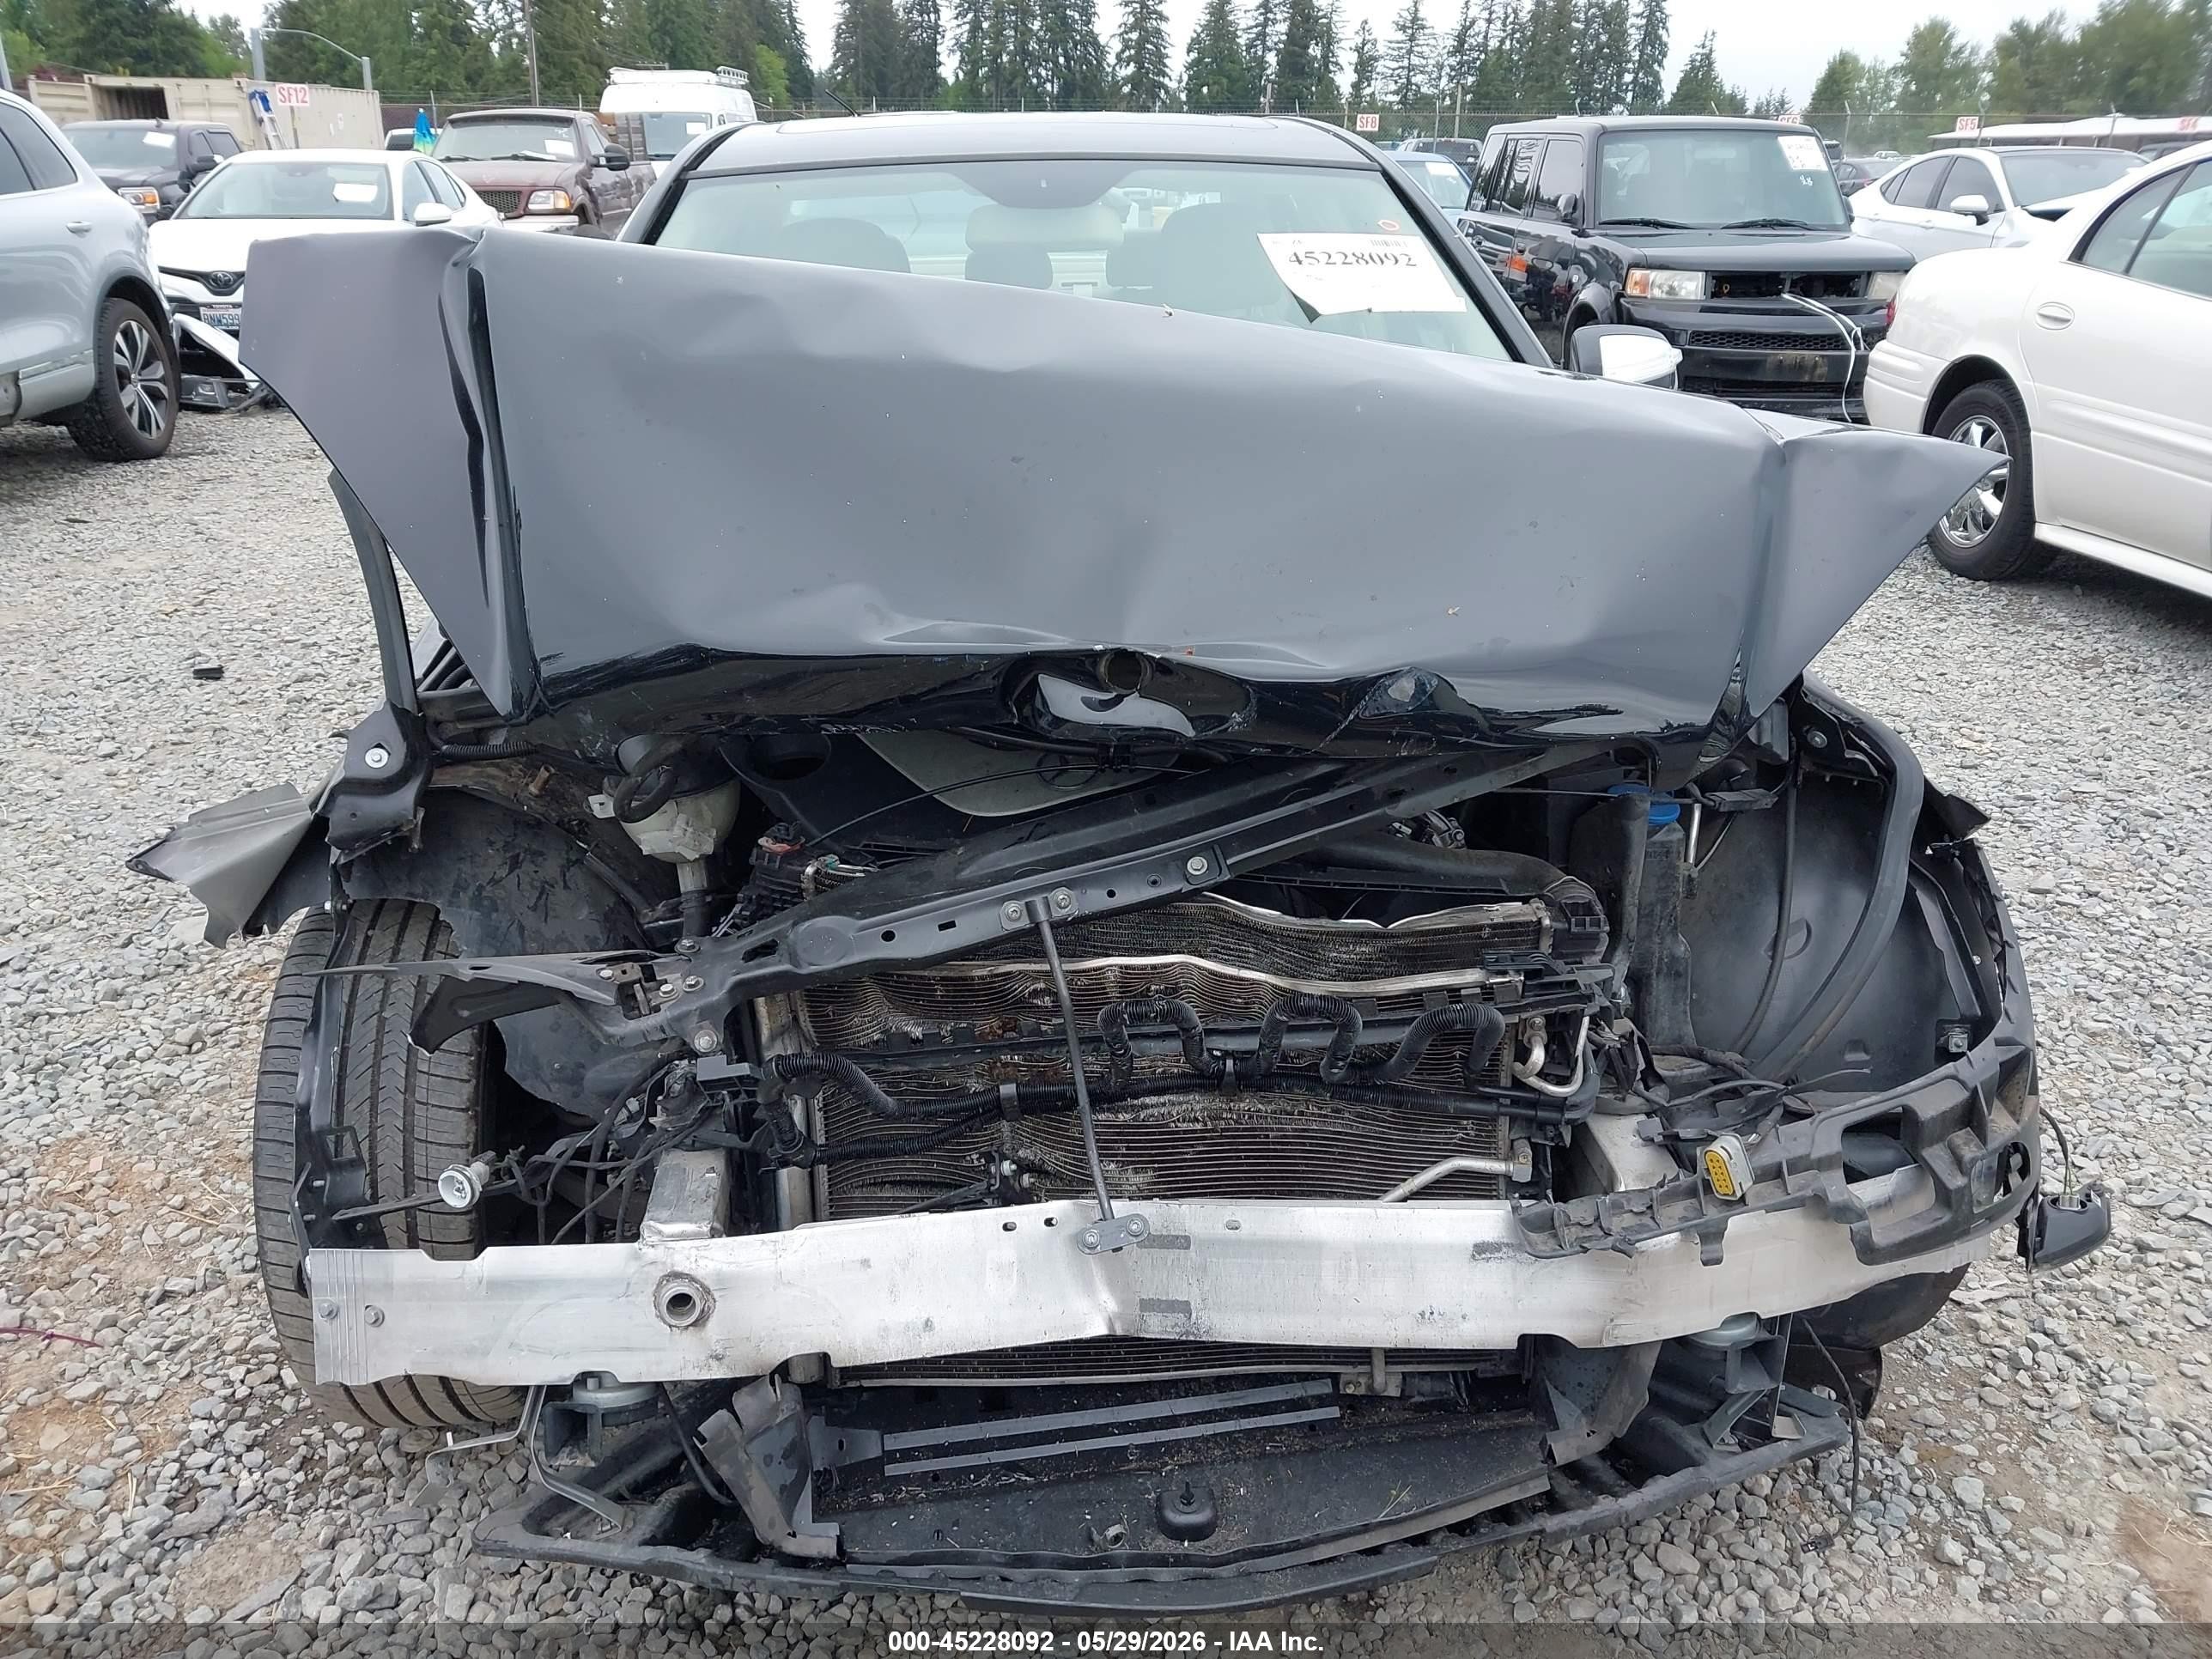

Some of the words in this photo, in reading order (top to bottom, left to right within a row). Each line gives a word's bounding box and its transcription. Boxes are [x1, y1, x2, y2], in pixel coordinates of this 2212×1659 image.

[278, 86, 308, 104] SF12
[1359, 115, 1377, 129] SF8
[1959, 118, 1978, 131] SF5
[1288, 250, 1418, 267] 45228092
